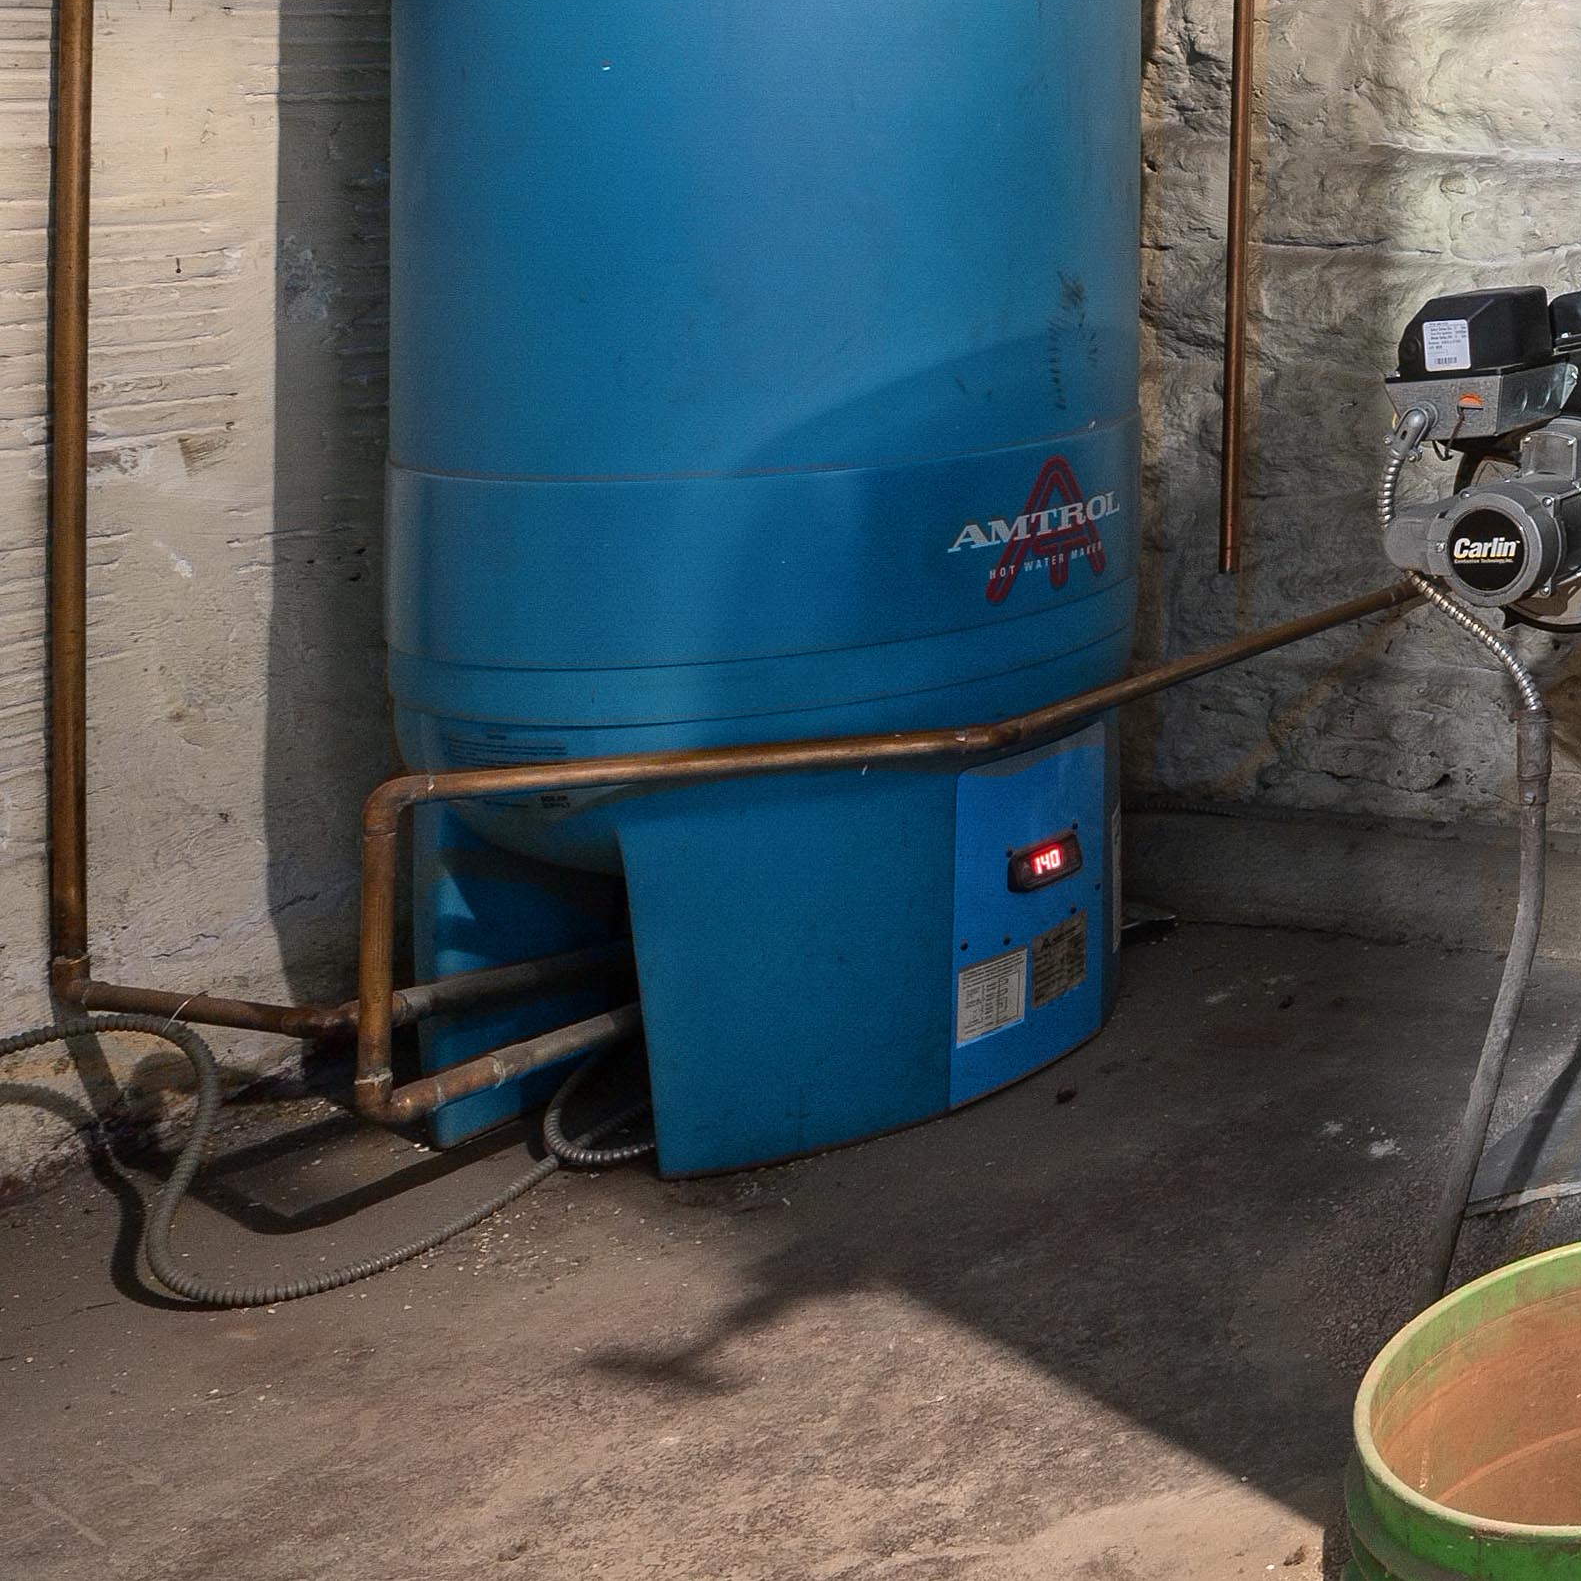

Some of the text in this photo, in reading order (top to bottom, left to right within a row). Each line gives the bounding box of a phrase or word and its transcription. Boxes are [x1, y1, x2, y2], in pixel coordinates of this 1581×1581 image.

[947, 491, 1120, 553] AMTROL
[989, 540, 1103, 580] HOT WATER MAKER
[1454, 537, 1516, 559] Carlin
[1034, 848, 1061, 874] 140
